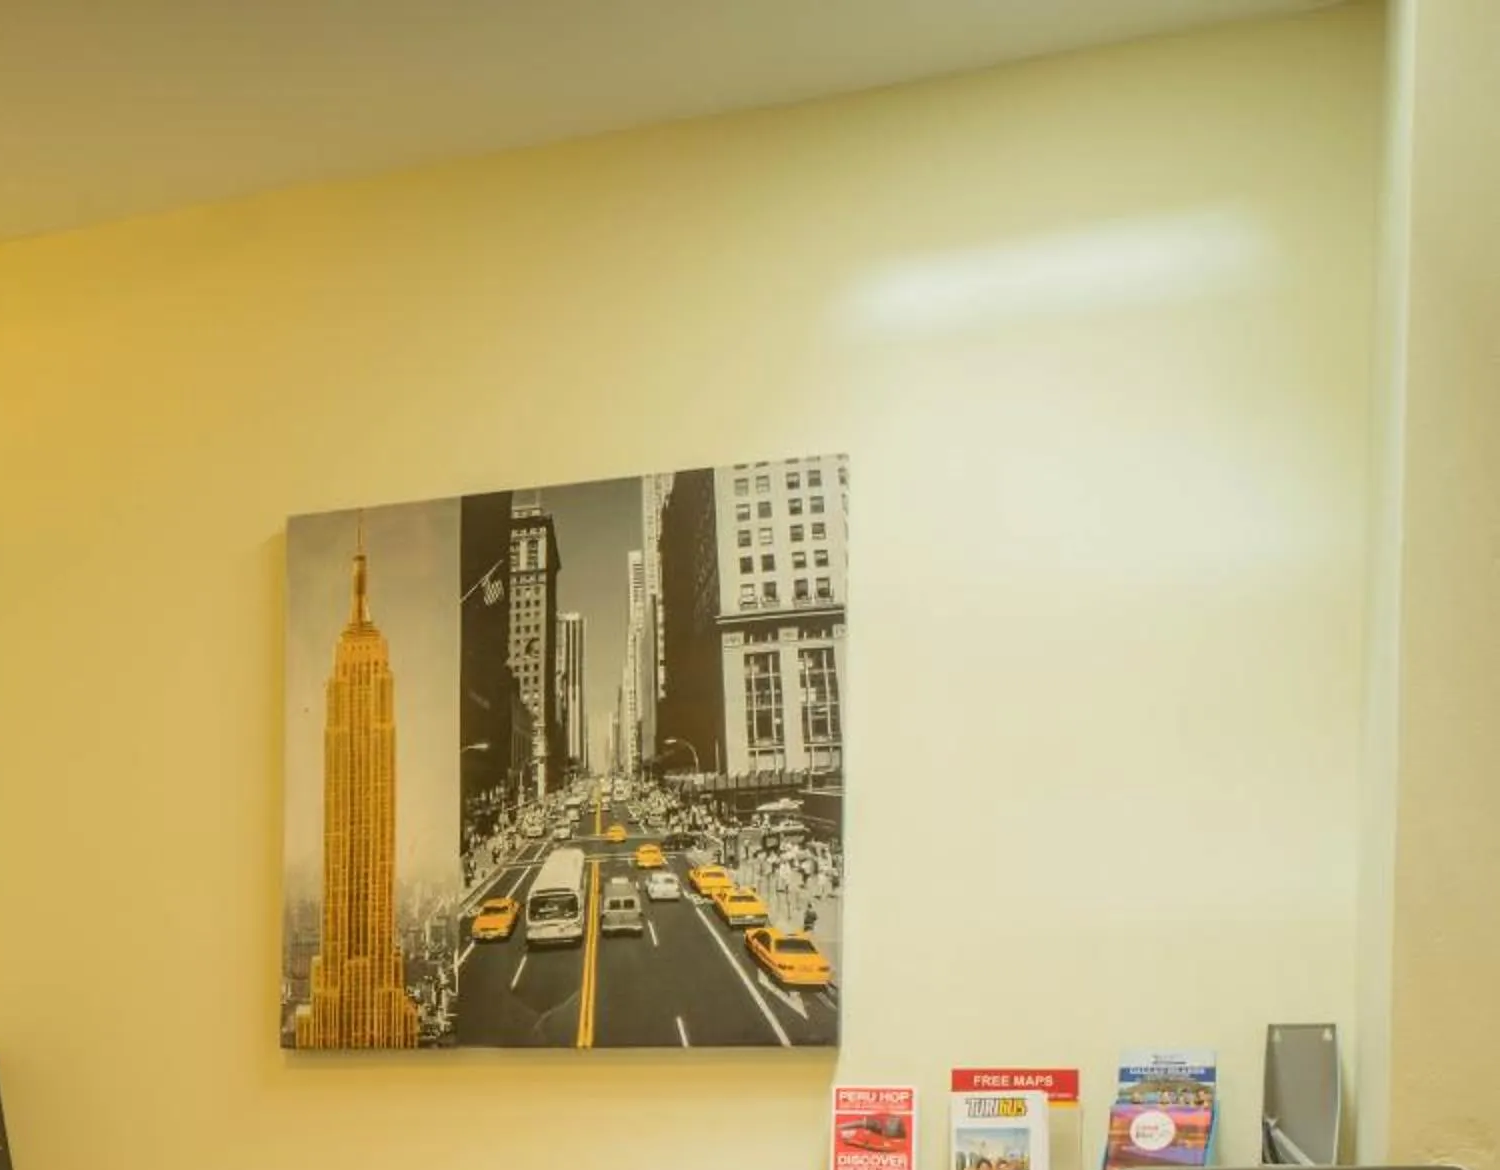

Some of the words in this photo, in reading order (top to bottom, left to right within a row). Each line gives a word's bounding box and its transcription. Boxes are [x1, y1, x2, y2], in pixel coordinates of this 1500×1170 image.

[973, 1075, 1009, 1087] FREE
[1013, 1075, 1053, 1087] MAPS
[839, 1091, 877, 1102] PERU
[838, 1155, 907, 1167] DISCOVER
